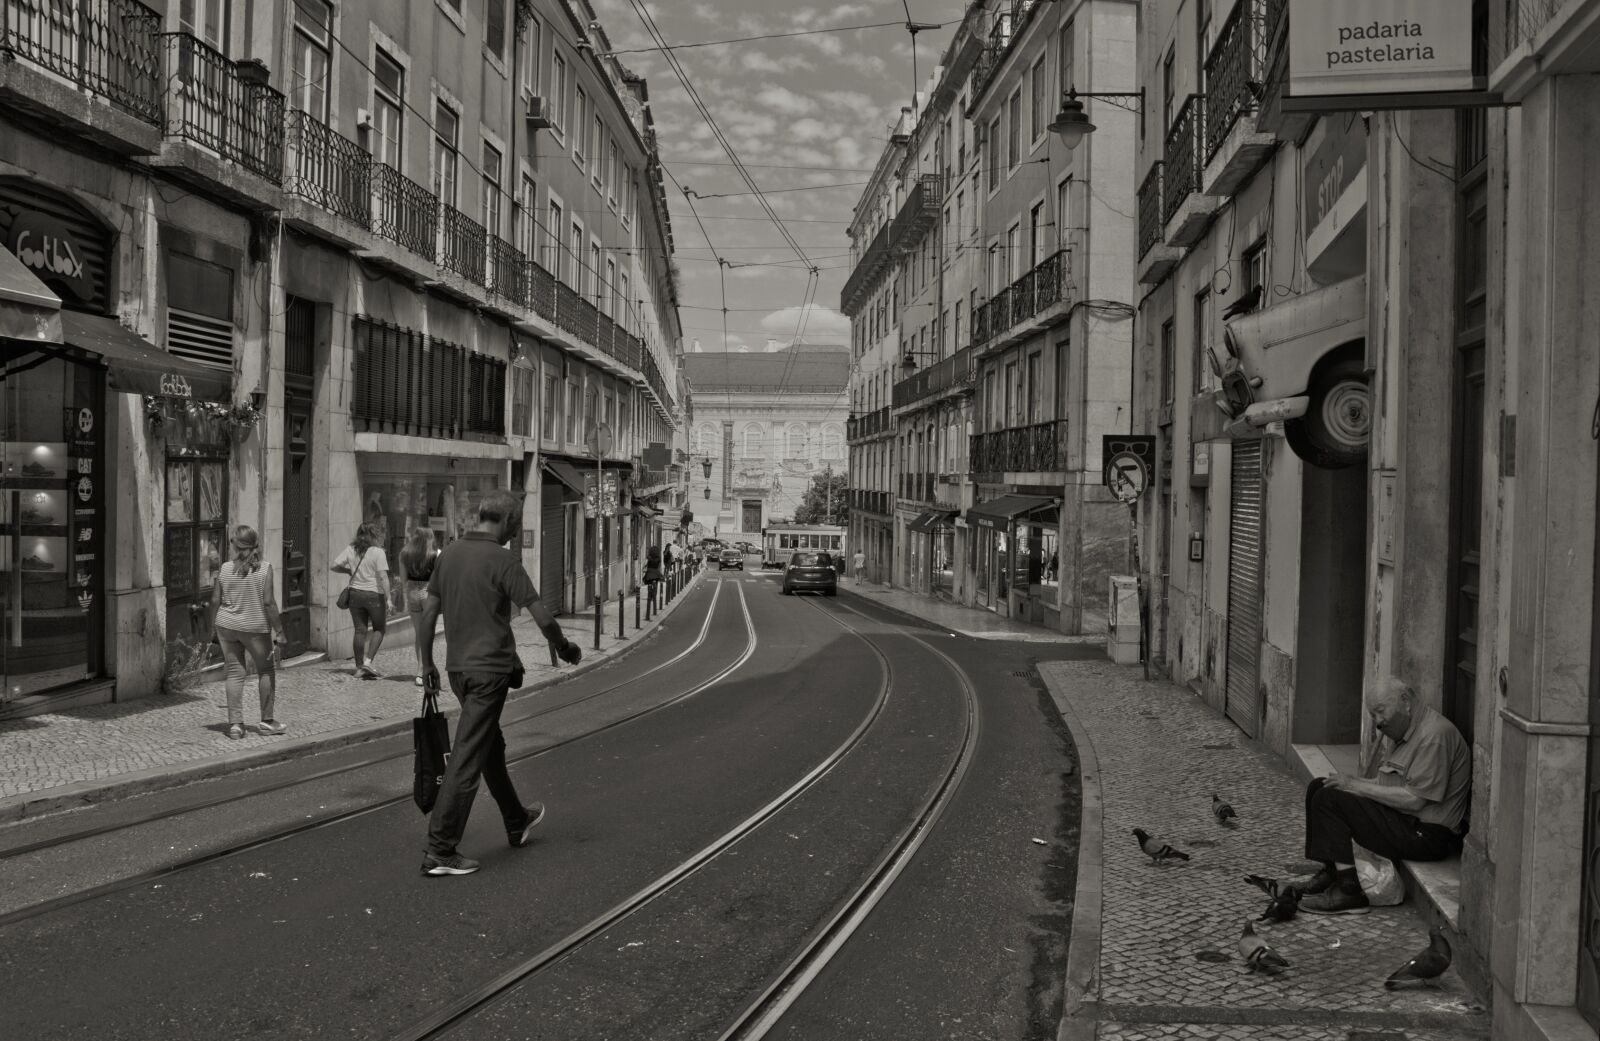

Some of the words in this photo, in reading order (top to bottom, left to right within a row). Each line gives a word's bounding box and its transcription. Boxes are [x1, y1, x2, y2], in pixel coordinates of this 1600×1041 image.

[1338, 19, 1423, 44] padaria
[1326, 42, 1435, 69] pastelaria
[78, 458, 93, 474] CAT
